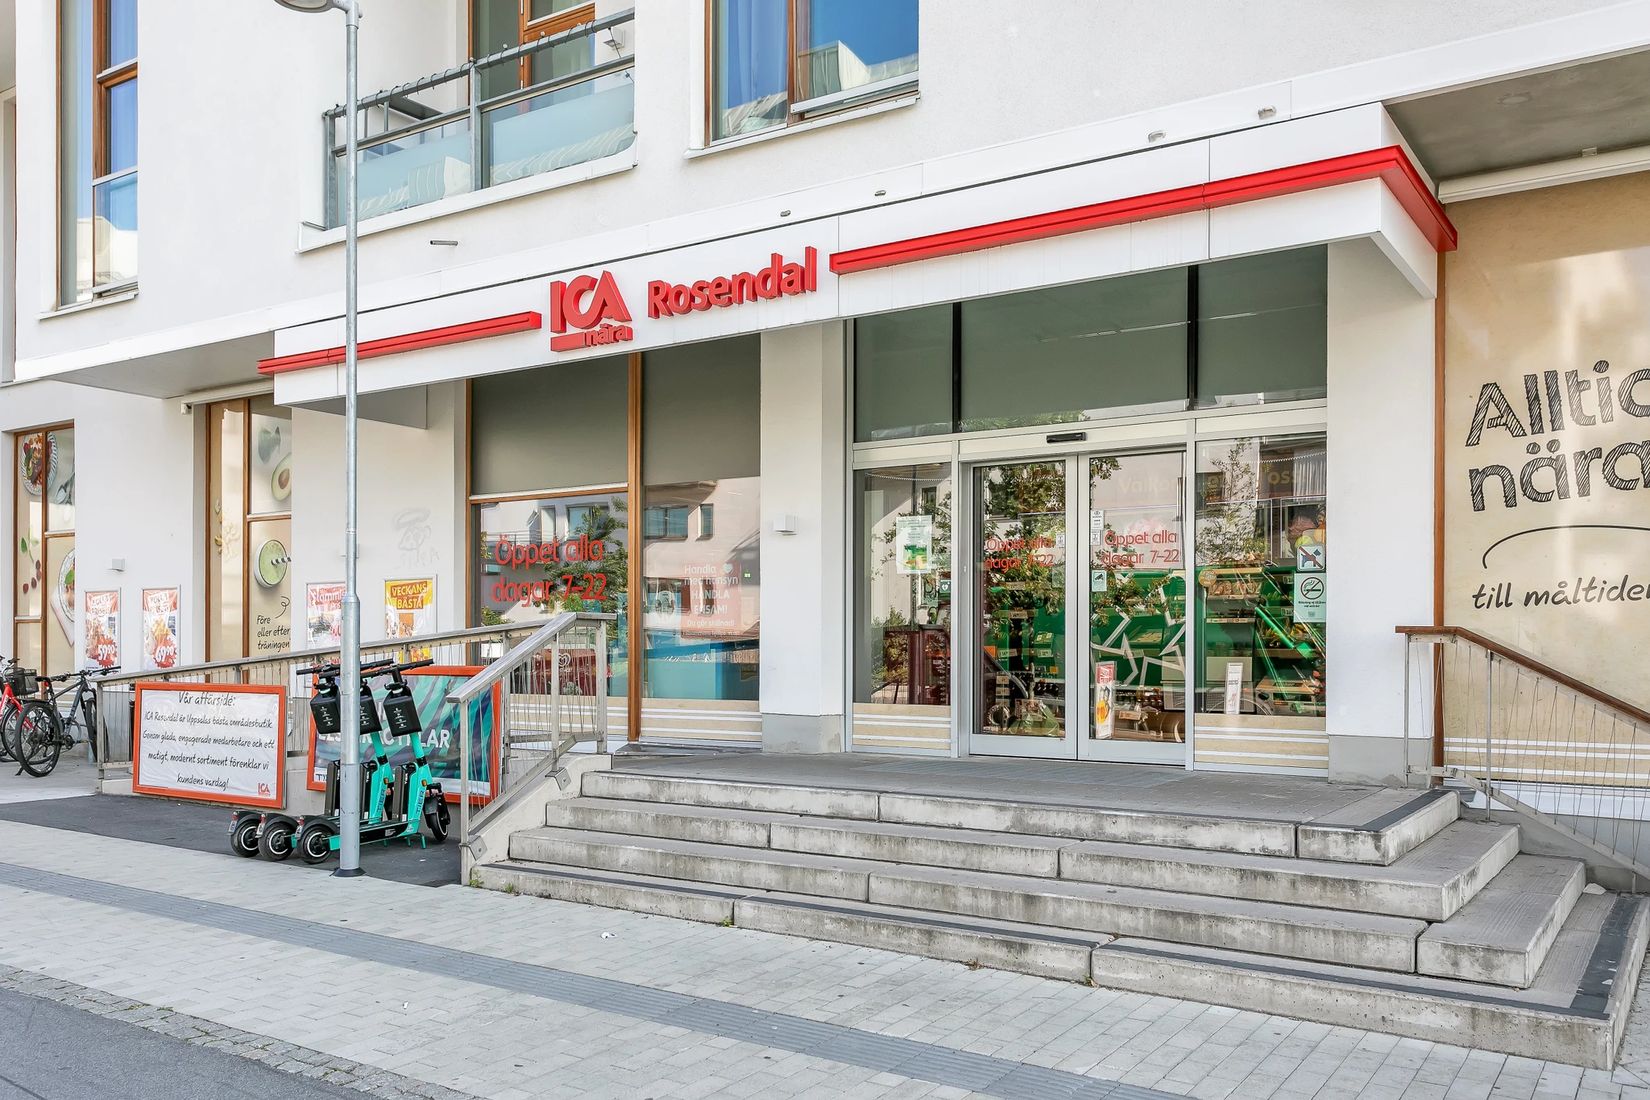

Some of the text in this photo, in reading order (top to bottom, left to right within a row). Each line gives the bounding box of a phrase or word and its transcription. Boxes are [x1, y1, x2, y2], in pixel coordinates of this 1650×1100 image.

[648, 246, 817, 319] Rosendal
[550, 270, 632, 333] ICA
[584, 323, 633, 347] nära
[1104, 529, 1177, 548] Öppet alla
[495, 534, 604, 570] Öppet alla
[1102, 551, 1144, 568] dagar
[684, 564, 716, 574] Handla
[391, 582, 428, 597] VECKANS
[491, 572, 608, 607] dagar 7-22
[1472, 582, 1514, 610] till
[397, 595, 423, 609] BÄSTA
[257, 615, 271, 625] Före
[257, 625, 290, 638] eller efter
[257, 640, 290, 653] träningen
[178, 691, 192, 705] Vår
[212, 735, 251, 748] medarbetare
[251, 737, 263, 748] och
[264, 739, 275, 749] ett
[170, 752, 196, 764] modernt
[197, 755, 228, 767] sortiment
[229, 758, 261, 770] förenklar
[262, 761, 270, 771] vi
[176, 772, 204, 786] kundens
[415, 790, 426, 815] TIER
